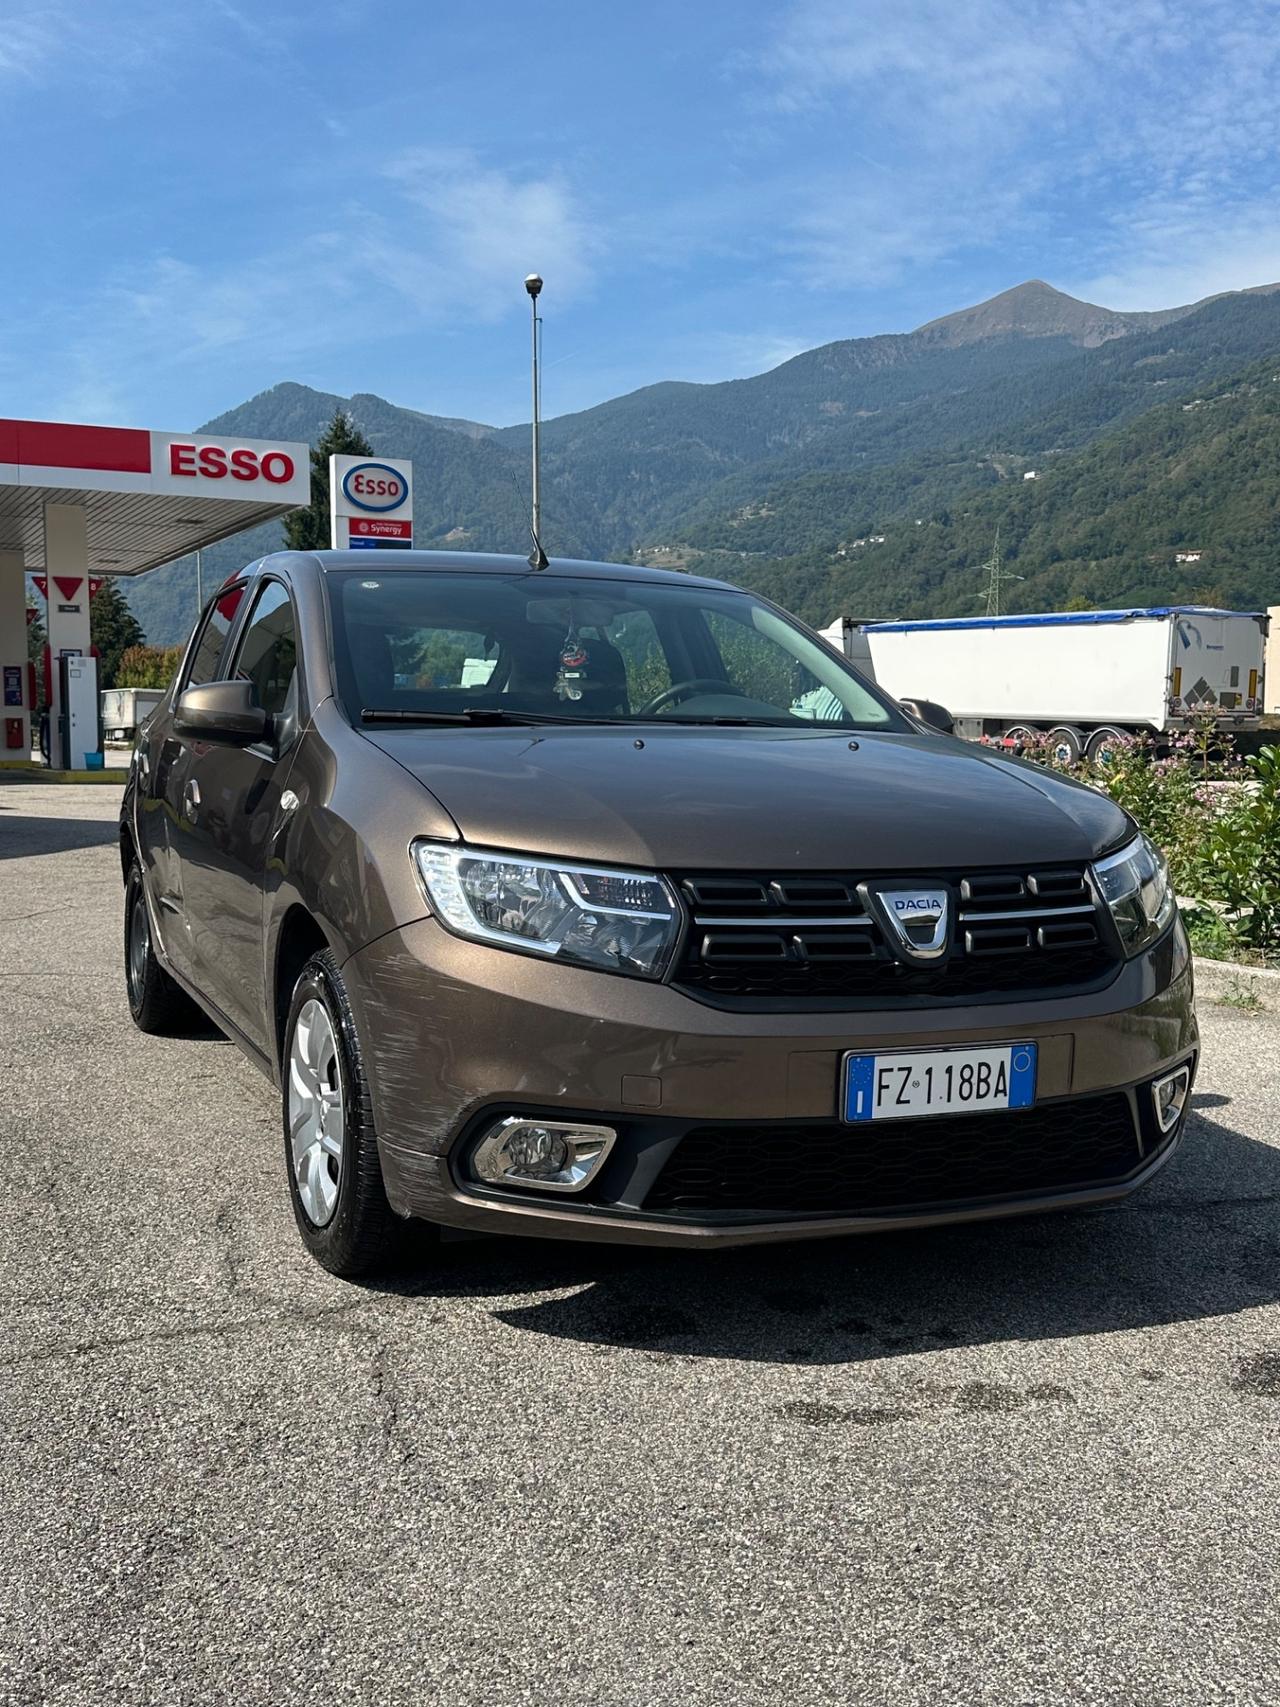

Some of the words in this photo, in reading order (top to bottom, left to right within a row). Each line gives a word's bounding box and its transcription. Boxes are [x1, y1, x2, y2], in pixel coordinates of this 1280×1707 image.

[170, 444, 294, 484] ESSO
[370, 523, 402, 535] Synergy
[40, 581, 46, 589] 7
[895, 899, 942, 910] DACIA
